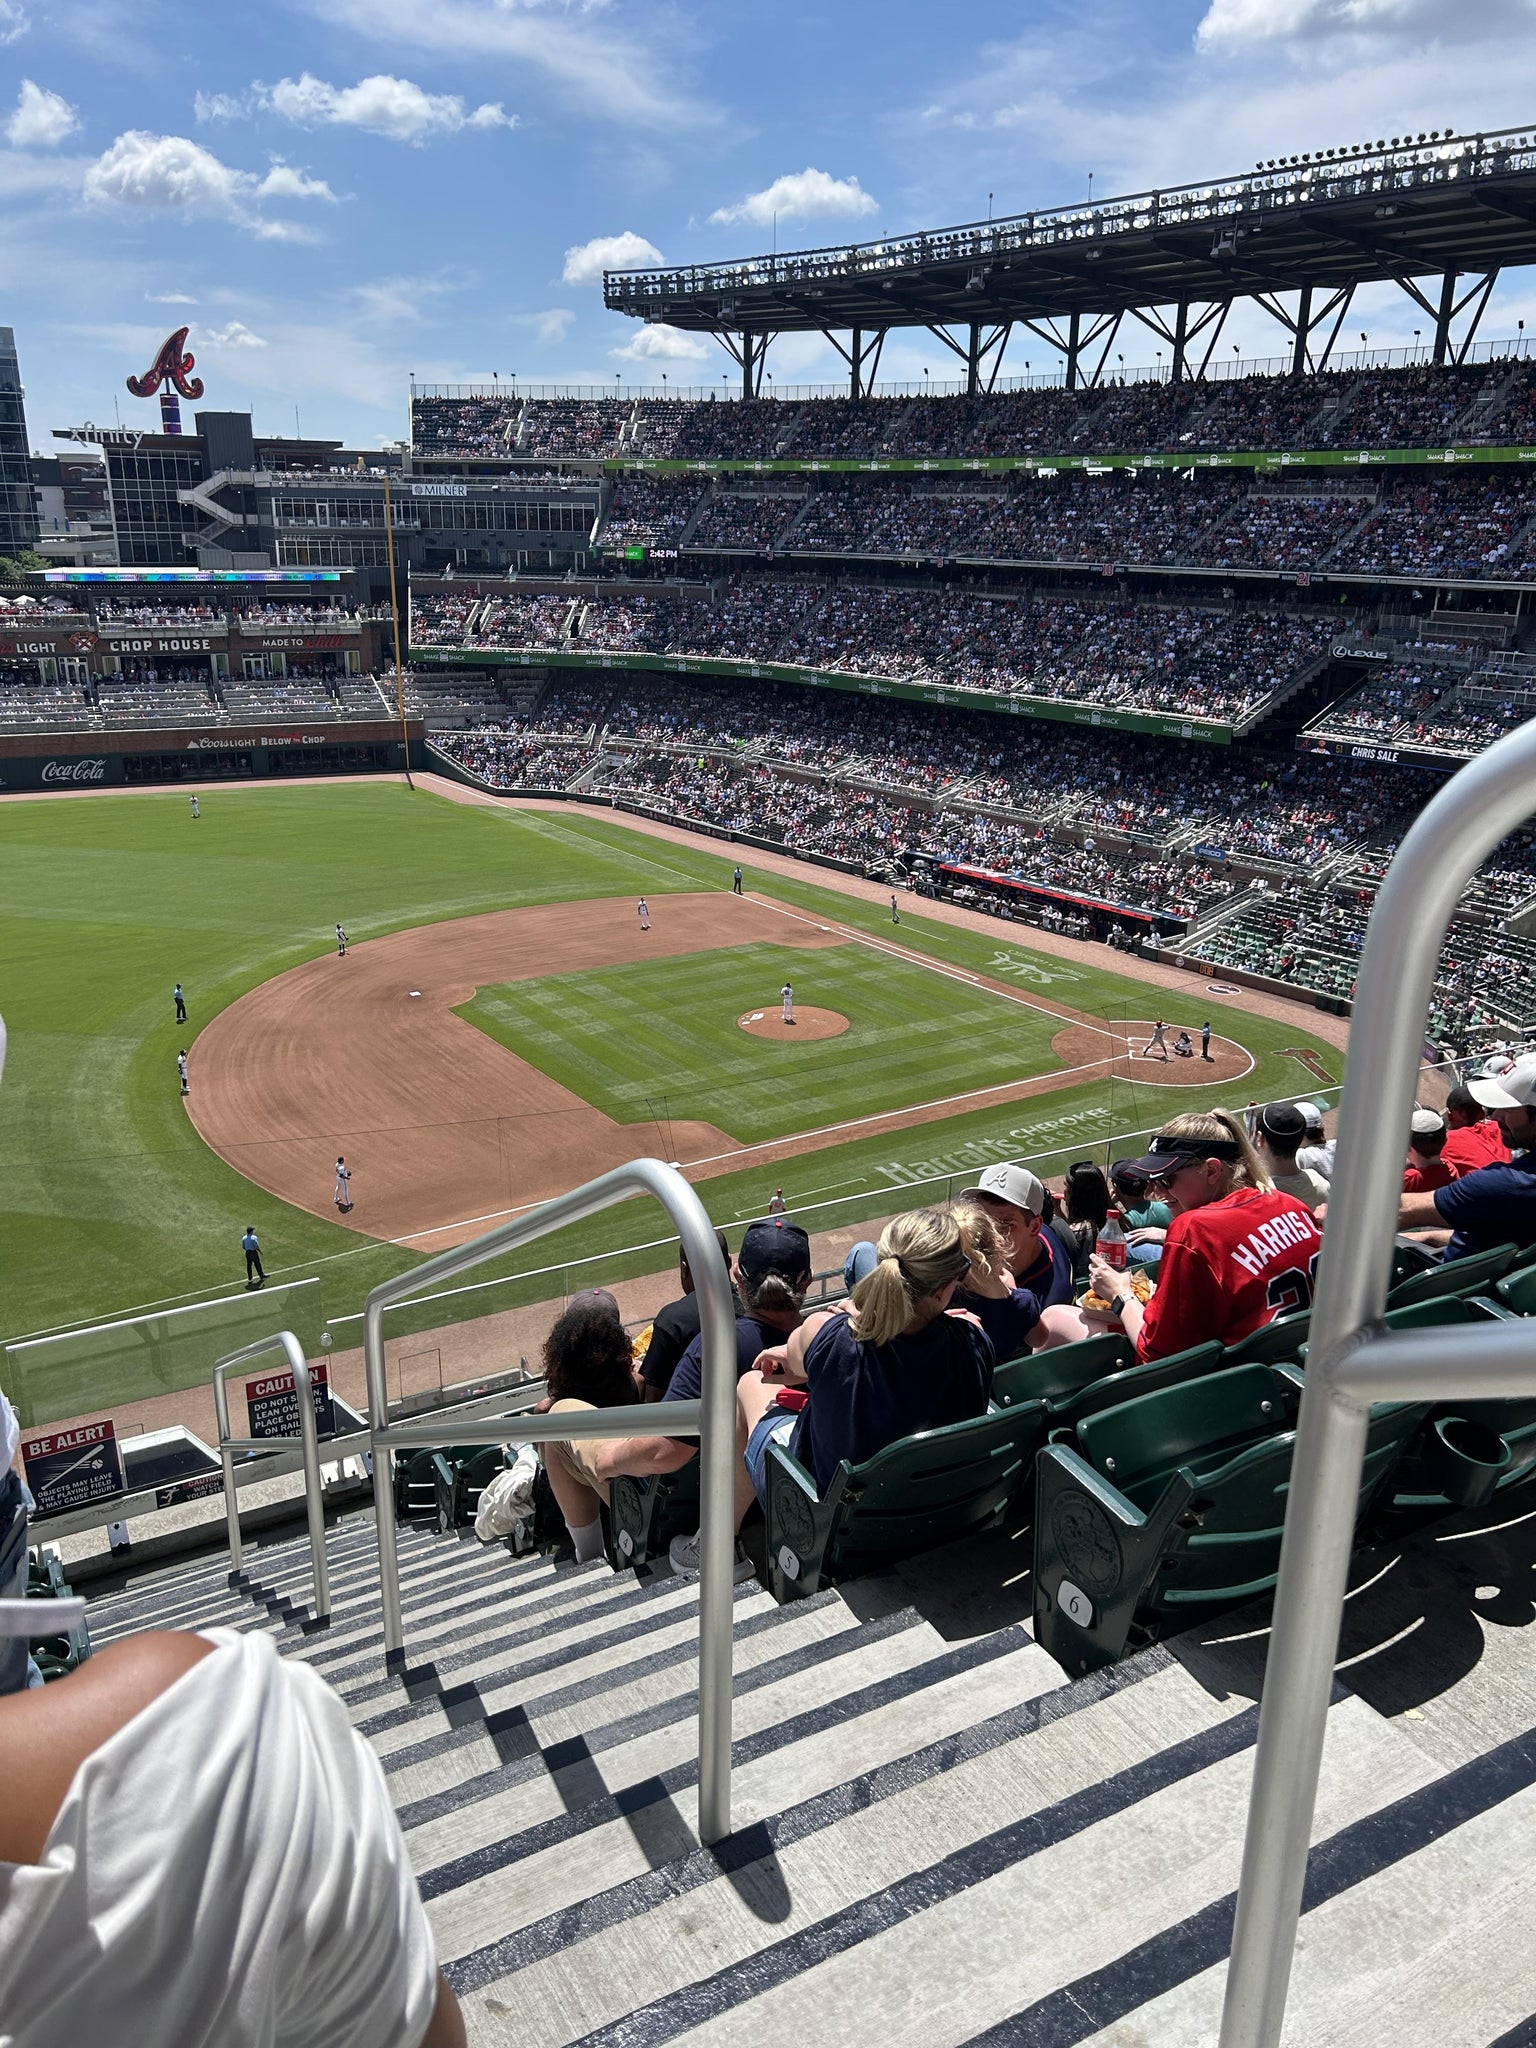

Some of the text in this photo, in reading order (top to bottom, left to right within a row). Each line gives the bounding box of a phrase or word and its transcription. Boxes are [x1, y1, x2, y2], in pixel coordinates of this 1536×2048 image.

[68, 421, 144, 449] xfinity
[424, 485, 465, 496] MILNER
[649, 549, 678, 558] 2:42 PM
[1297, 571, 1310, 586] 21
[16, 642, 56, 653] LIGHT
[110, 639, 211, 652] CHOP HOUSE
[262, 638, 289, 647] MADE
[291, 638, 303, 646] TO
[1347, 650, 1388, 659] LEXUS
[1074, 713, 1119, 725] SHAKE SHACK
[1162, 725, 1213, 738] SHAKE SHACK
[199, 737, 229, 749] Coors
[229, 738, 256, 747] LIGHT
[261, 737, 291, 746] BELOW
[302, 735, 326, 744] CHOP
[1335, 744, 1400, 762] 51 CHRIS SALE
[42, 759, 107, 782] Coca-Cola
[1009, 1107, 1113, 1140] CHEROKEE
[1026, 1114, 1131, 1148] CASINOS
[1231, 1210, 1312, 1276] HARRIS
[256, 1369, 319, 1395] CAUTN
[254, 1402, 268, 1412] DO
[270, 1397, 288, 1408] NOT
[256, 1408, 280, 1420] LEAN
[282, 1403, 300, 1413] OVE
[255, 1415, 284, 1429] PLACE
[265, 1426, 278, 1435] ON
[29, 1424, 105, 1457] BE ALERT
[38, 1472, 113, 1498] OBJECTS MAY LEAVE
[41, 1479, 112, 1504] THE PLAYING FIELD
[193, 1481, 219, 1492] WATCH
[46, 1500, 62, 1509] MAY
[64, 1491, 89, 1505] CAUSE
[90, 1483, 117, 1496] INJURY
[186, 1491, 207, 1500] YOUR
[785, 1556, 792, 1569] 5
[1069, 1596, 1081, 1614] 6
